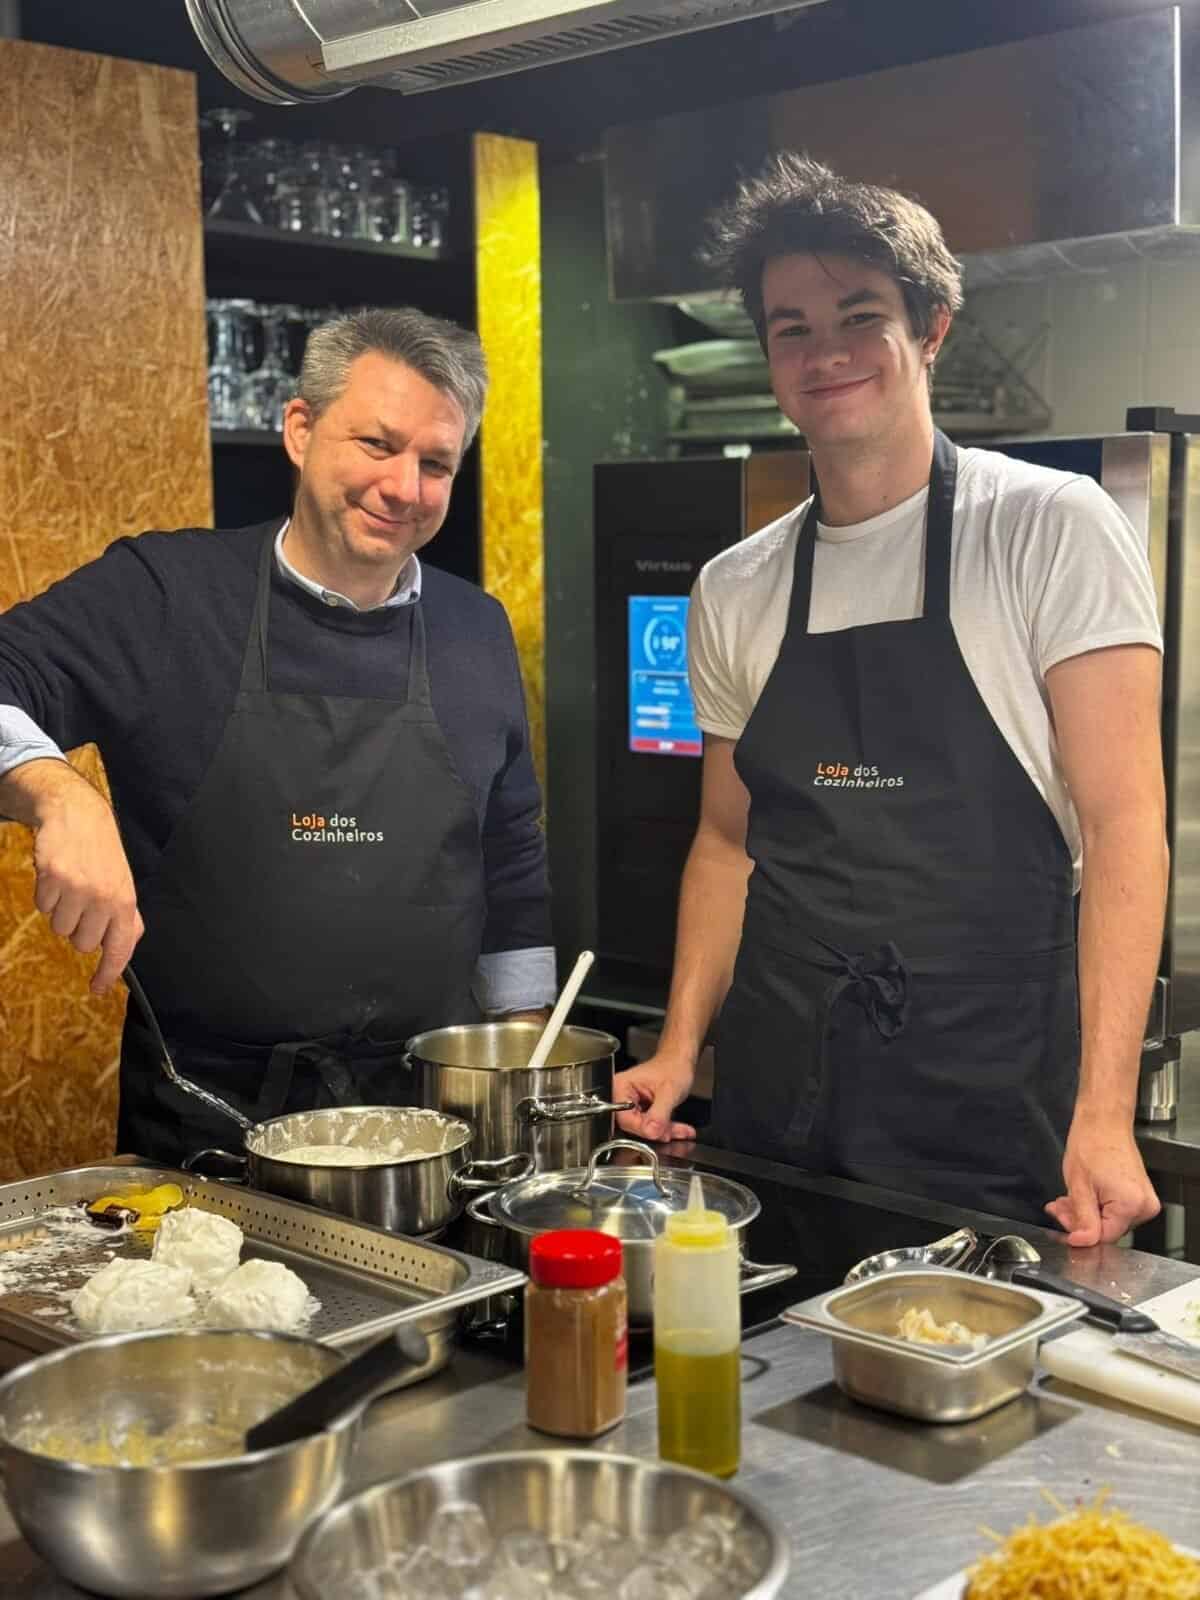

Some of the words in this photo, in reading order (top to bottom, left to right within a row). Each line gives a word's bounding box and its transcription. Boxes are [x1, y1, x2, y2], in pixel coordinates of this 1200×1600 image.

[817, 762, 849, 778] Loja
[853, 764, 879, 777] dos
[813, 776, 904, 788] Cozinheiros
[292, 813, 326, 829] Loja
[329, 813, 357, 827] dos
[291, 828, 384, 842] Cozinheiros
